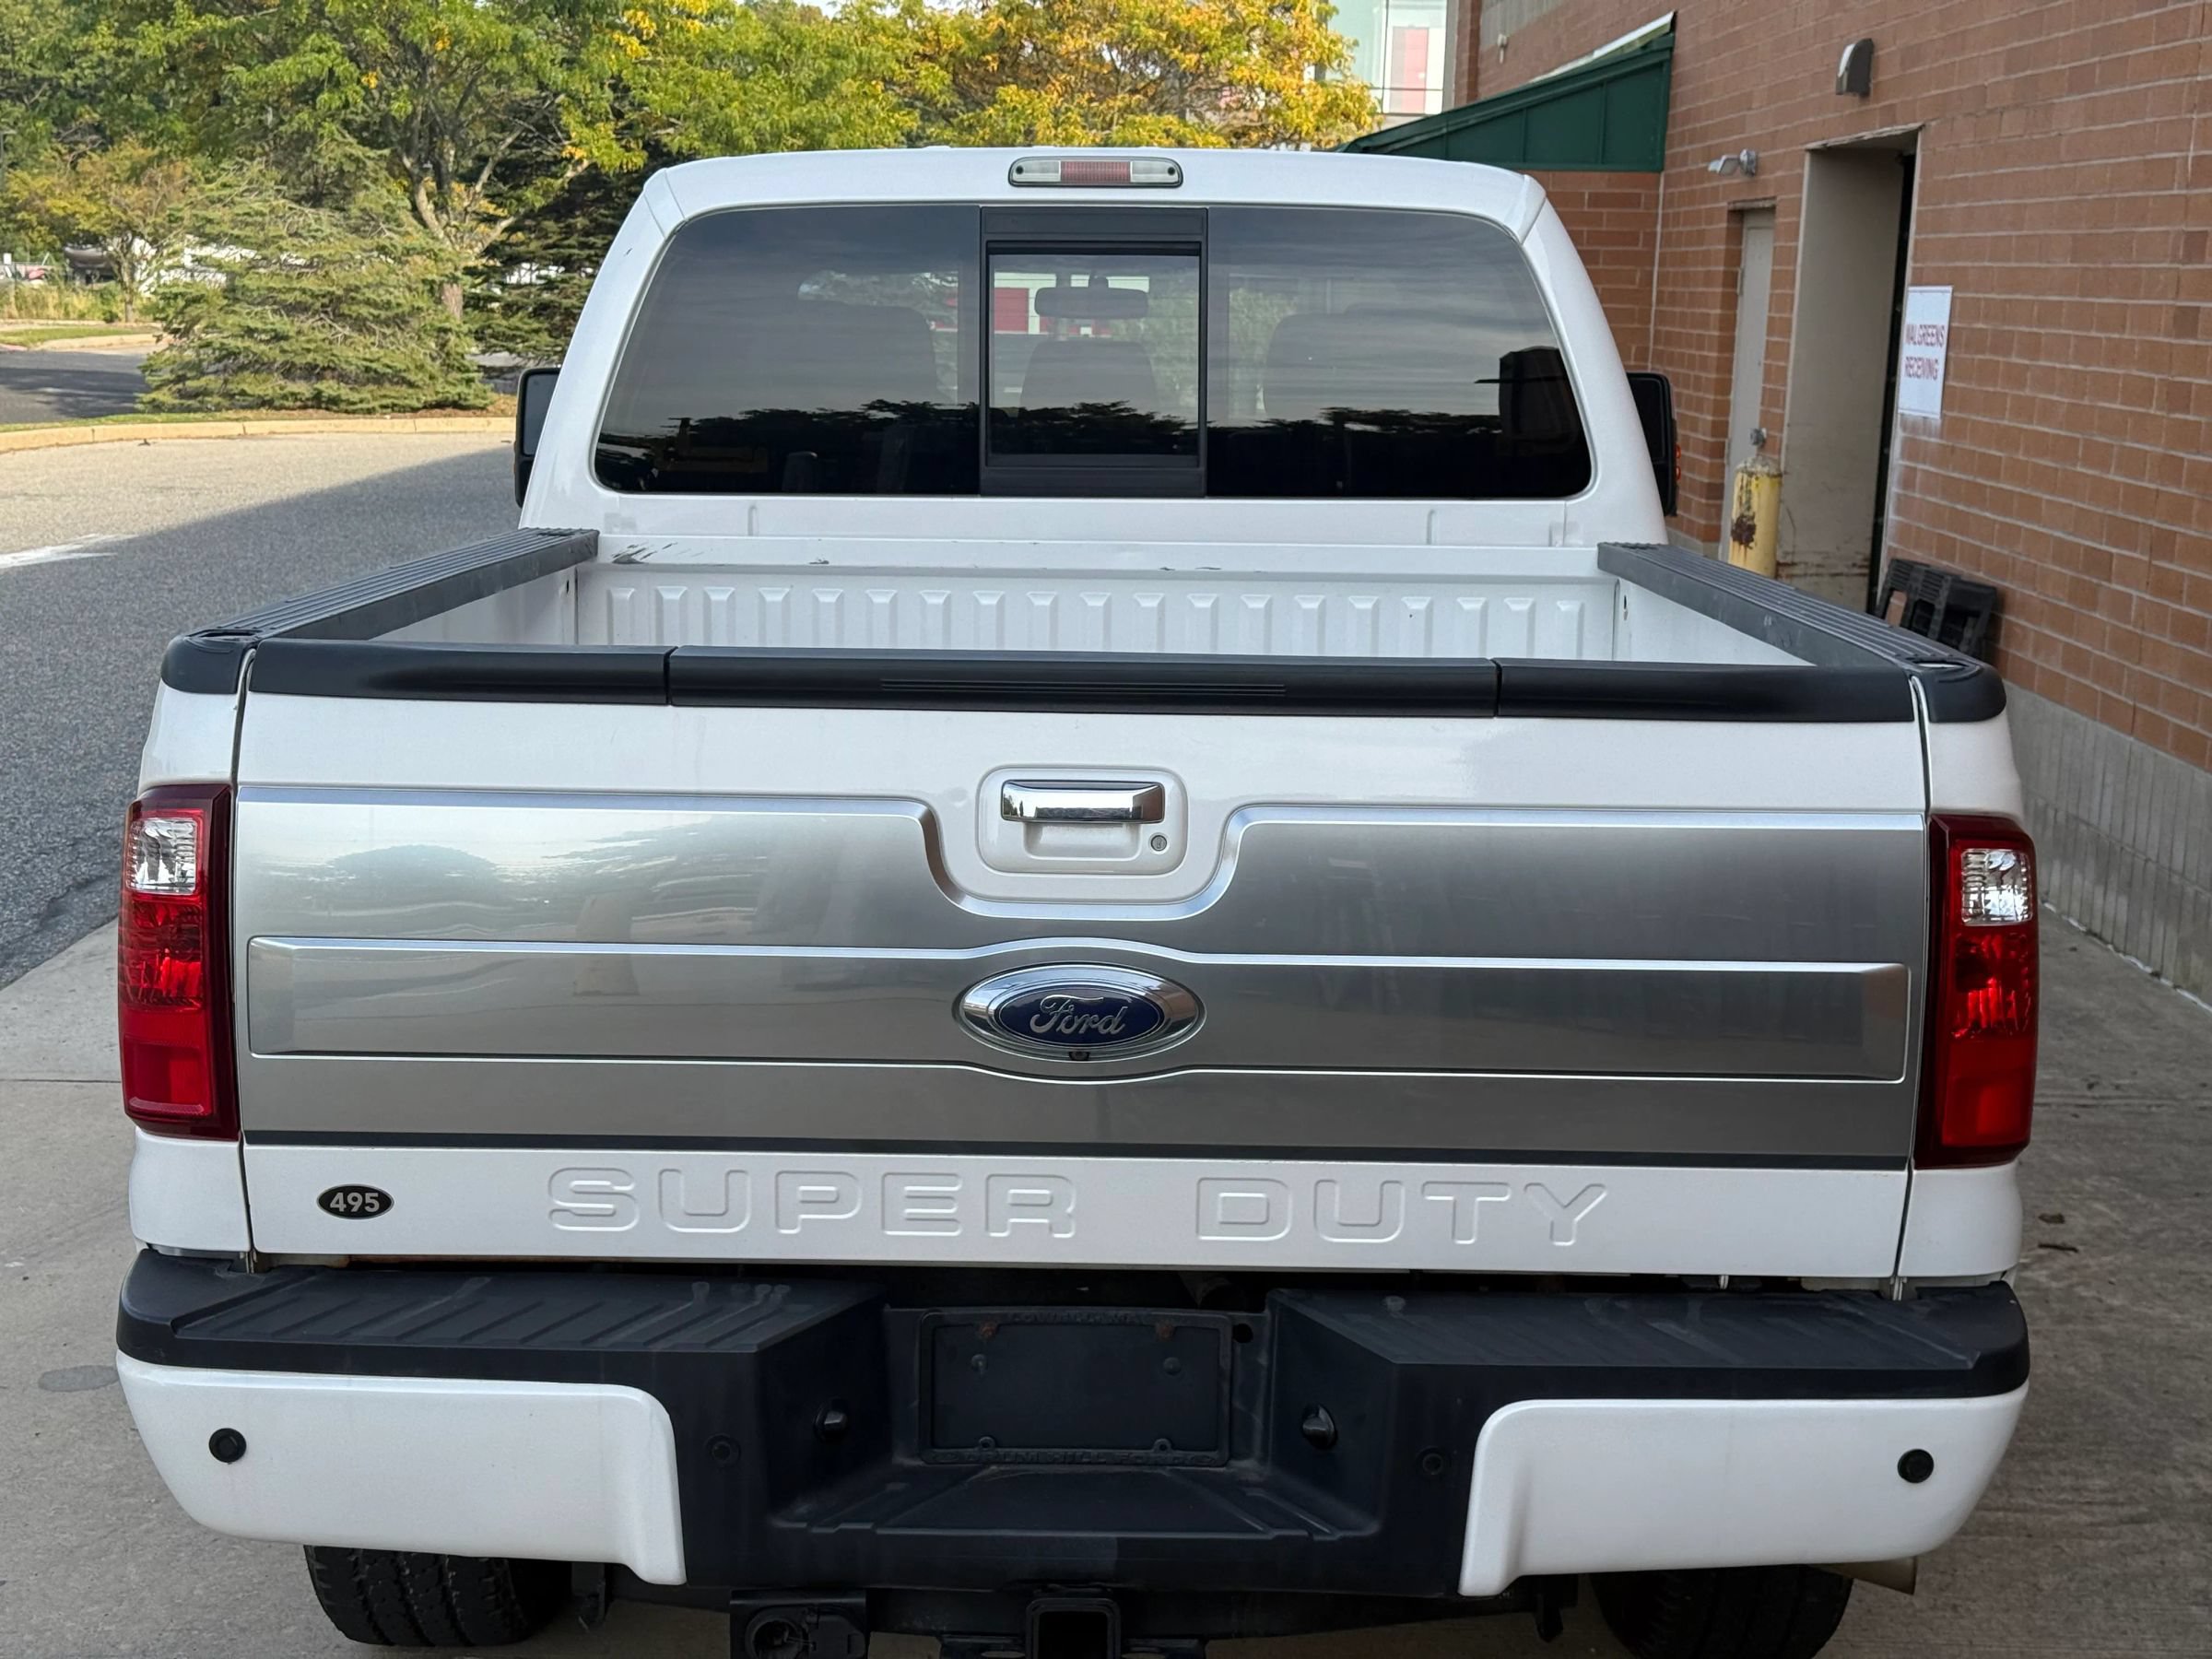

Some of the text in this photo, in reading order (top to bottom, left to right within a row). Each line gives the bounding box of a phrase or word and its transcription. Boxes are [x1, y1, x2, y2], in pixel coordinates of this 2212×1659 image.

[1905, 324, 1945, 347] WALGREENS
[1904, 356, 1939, 380] RECEIVING
[1030, 994, 1128, 1035] Ford
[330, 1192, 380, 1213] 495
[548, 1168, 1607, 1246] SUPER DUTY
